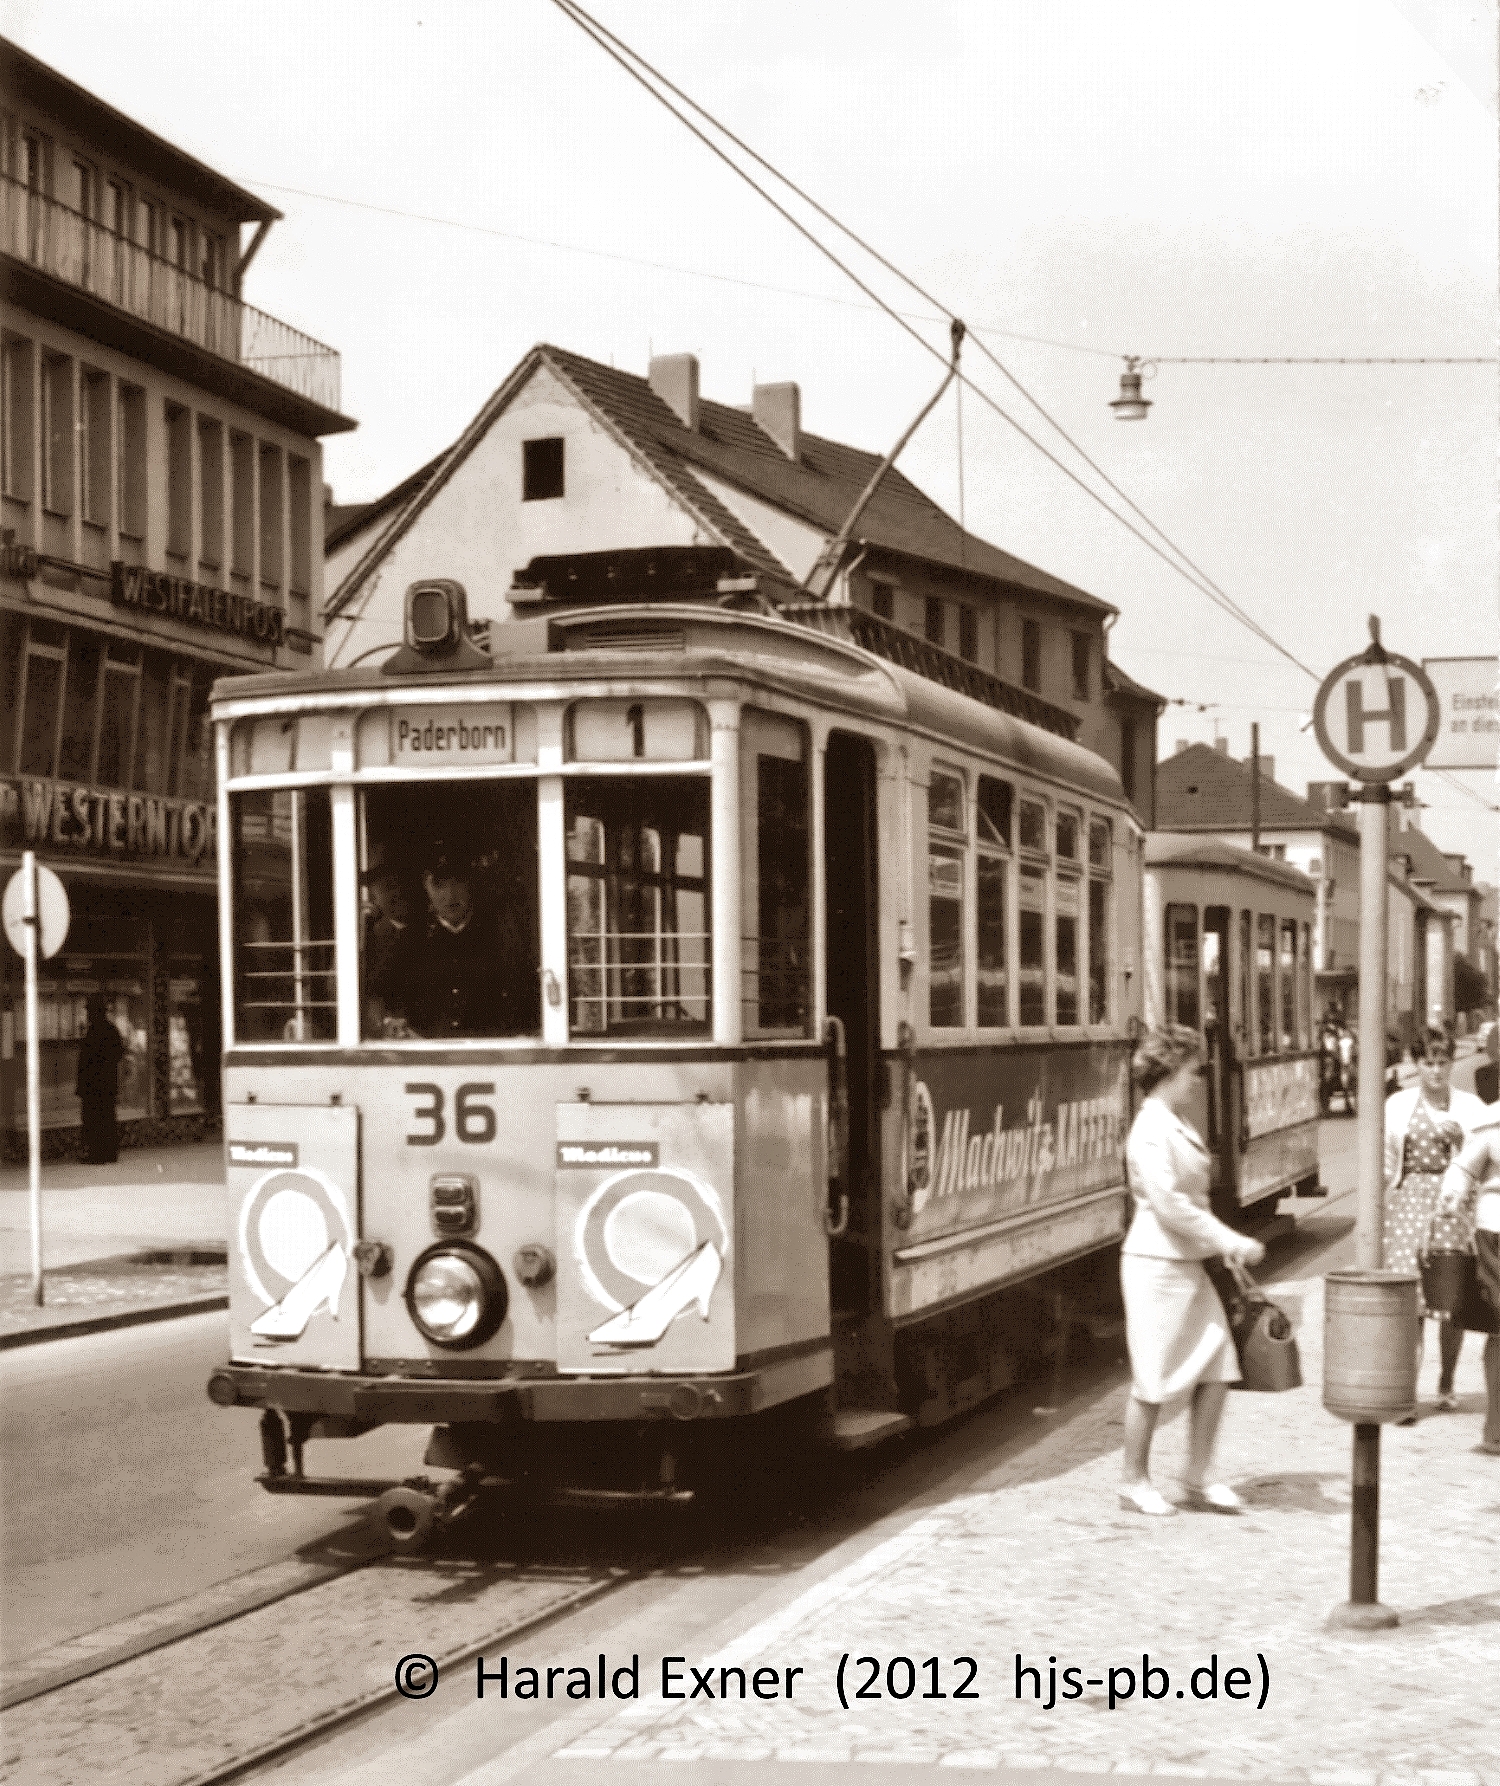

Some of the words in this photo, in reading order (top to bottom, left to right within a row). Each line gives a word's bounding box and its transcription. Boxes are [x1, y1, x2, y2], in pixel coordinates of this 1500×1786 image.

[399, 719, 506, 752] Paderborn
[626, 703, 645, 757] 1
[1346, 676, 1407, 754] H
[406, 1083, 497, 1146] 36
